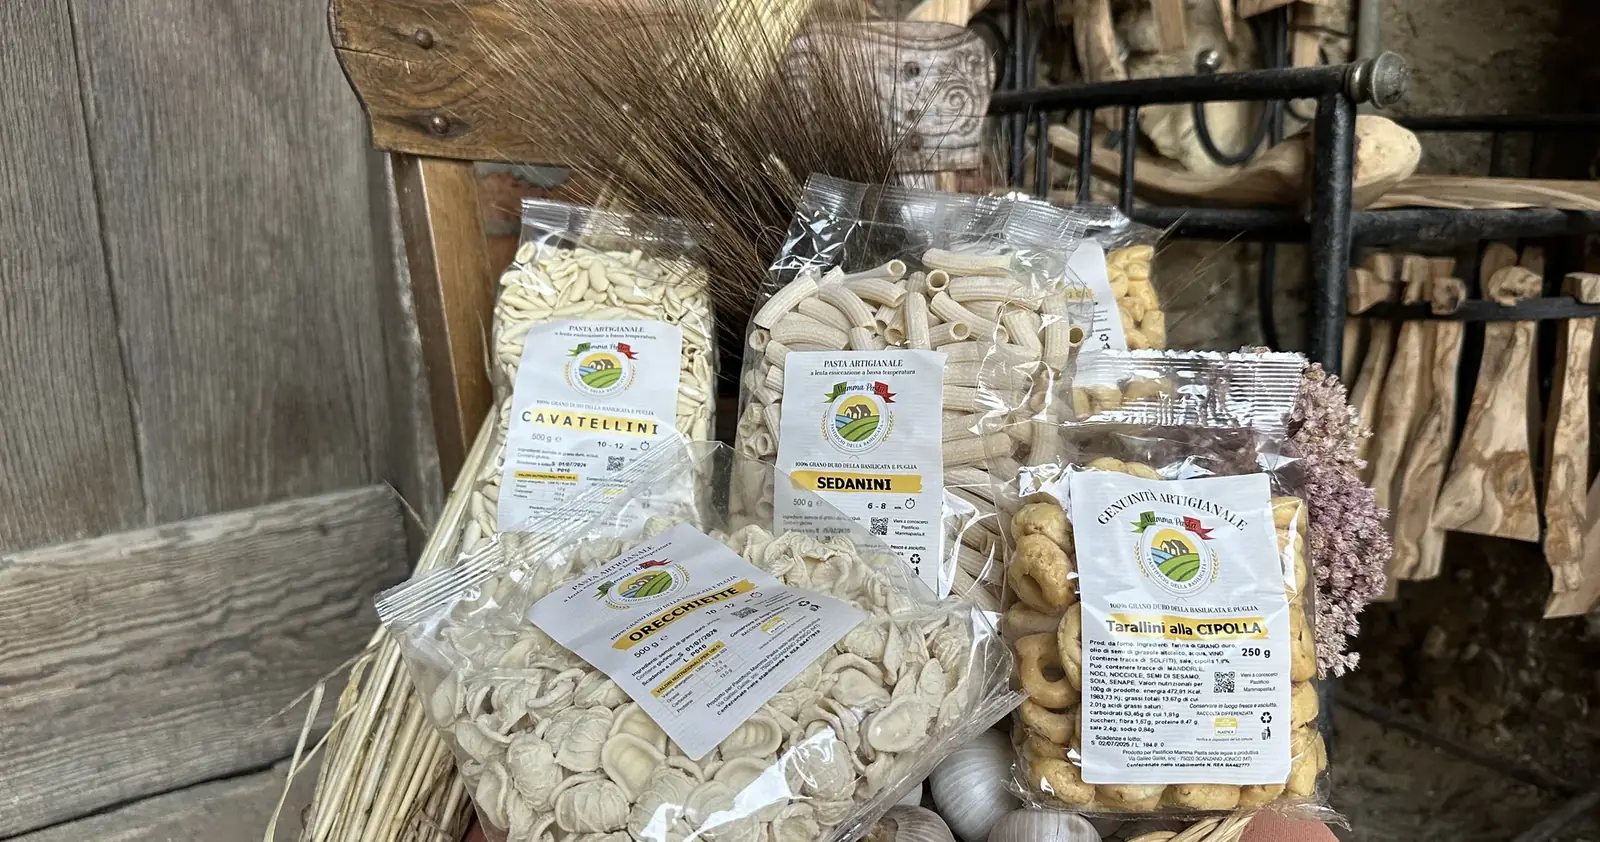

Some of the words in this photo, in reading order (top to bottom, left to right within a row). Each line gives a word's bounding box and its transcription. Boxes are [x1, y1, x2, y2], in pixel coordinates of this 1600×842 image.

[823, 360, 847, 368] PASTA
[849, 359, 904, 368] ARTIGIANALE
[521, 411, 659, 435] CAVATELLINI
[531, 433, 545, 441] 500
[817, 476, 892, 491] SEDANINI
[792, 498, 806, 506] 500
[1097, 489, 1156, 526] GENUINITÀ
[1159, 493, 1248, 531] ARTIGIANALE
[1144, 511, 1174, 525] Mamma
[1175, 516, 1197, 530] Pasta
[629, 587, 739, 642] ORECCHIETTE
[1170, 605, 1189, 613] DELLA
[1233, 605, 1259, 613] PUGLIA
[633, 645, 652, 659] 500
[705, 608, 718, 617] 10
[723, 601, 736, 610] 12
[1105, 620, 1166, 634] Tarallini
[1169, 624, 1193, 635] alla
[1196, 622, 1262, 635] CIPOLLA
[684, 628, 719, 652] 01/07/2026
[1241, 647, 1261, 657] 250
[1264, 649, 1271, 658] g
